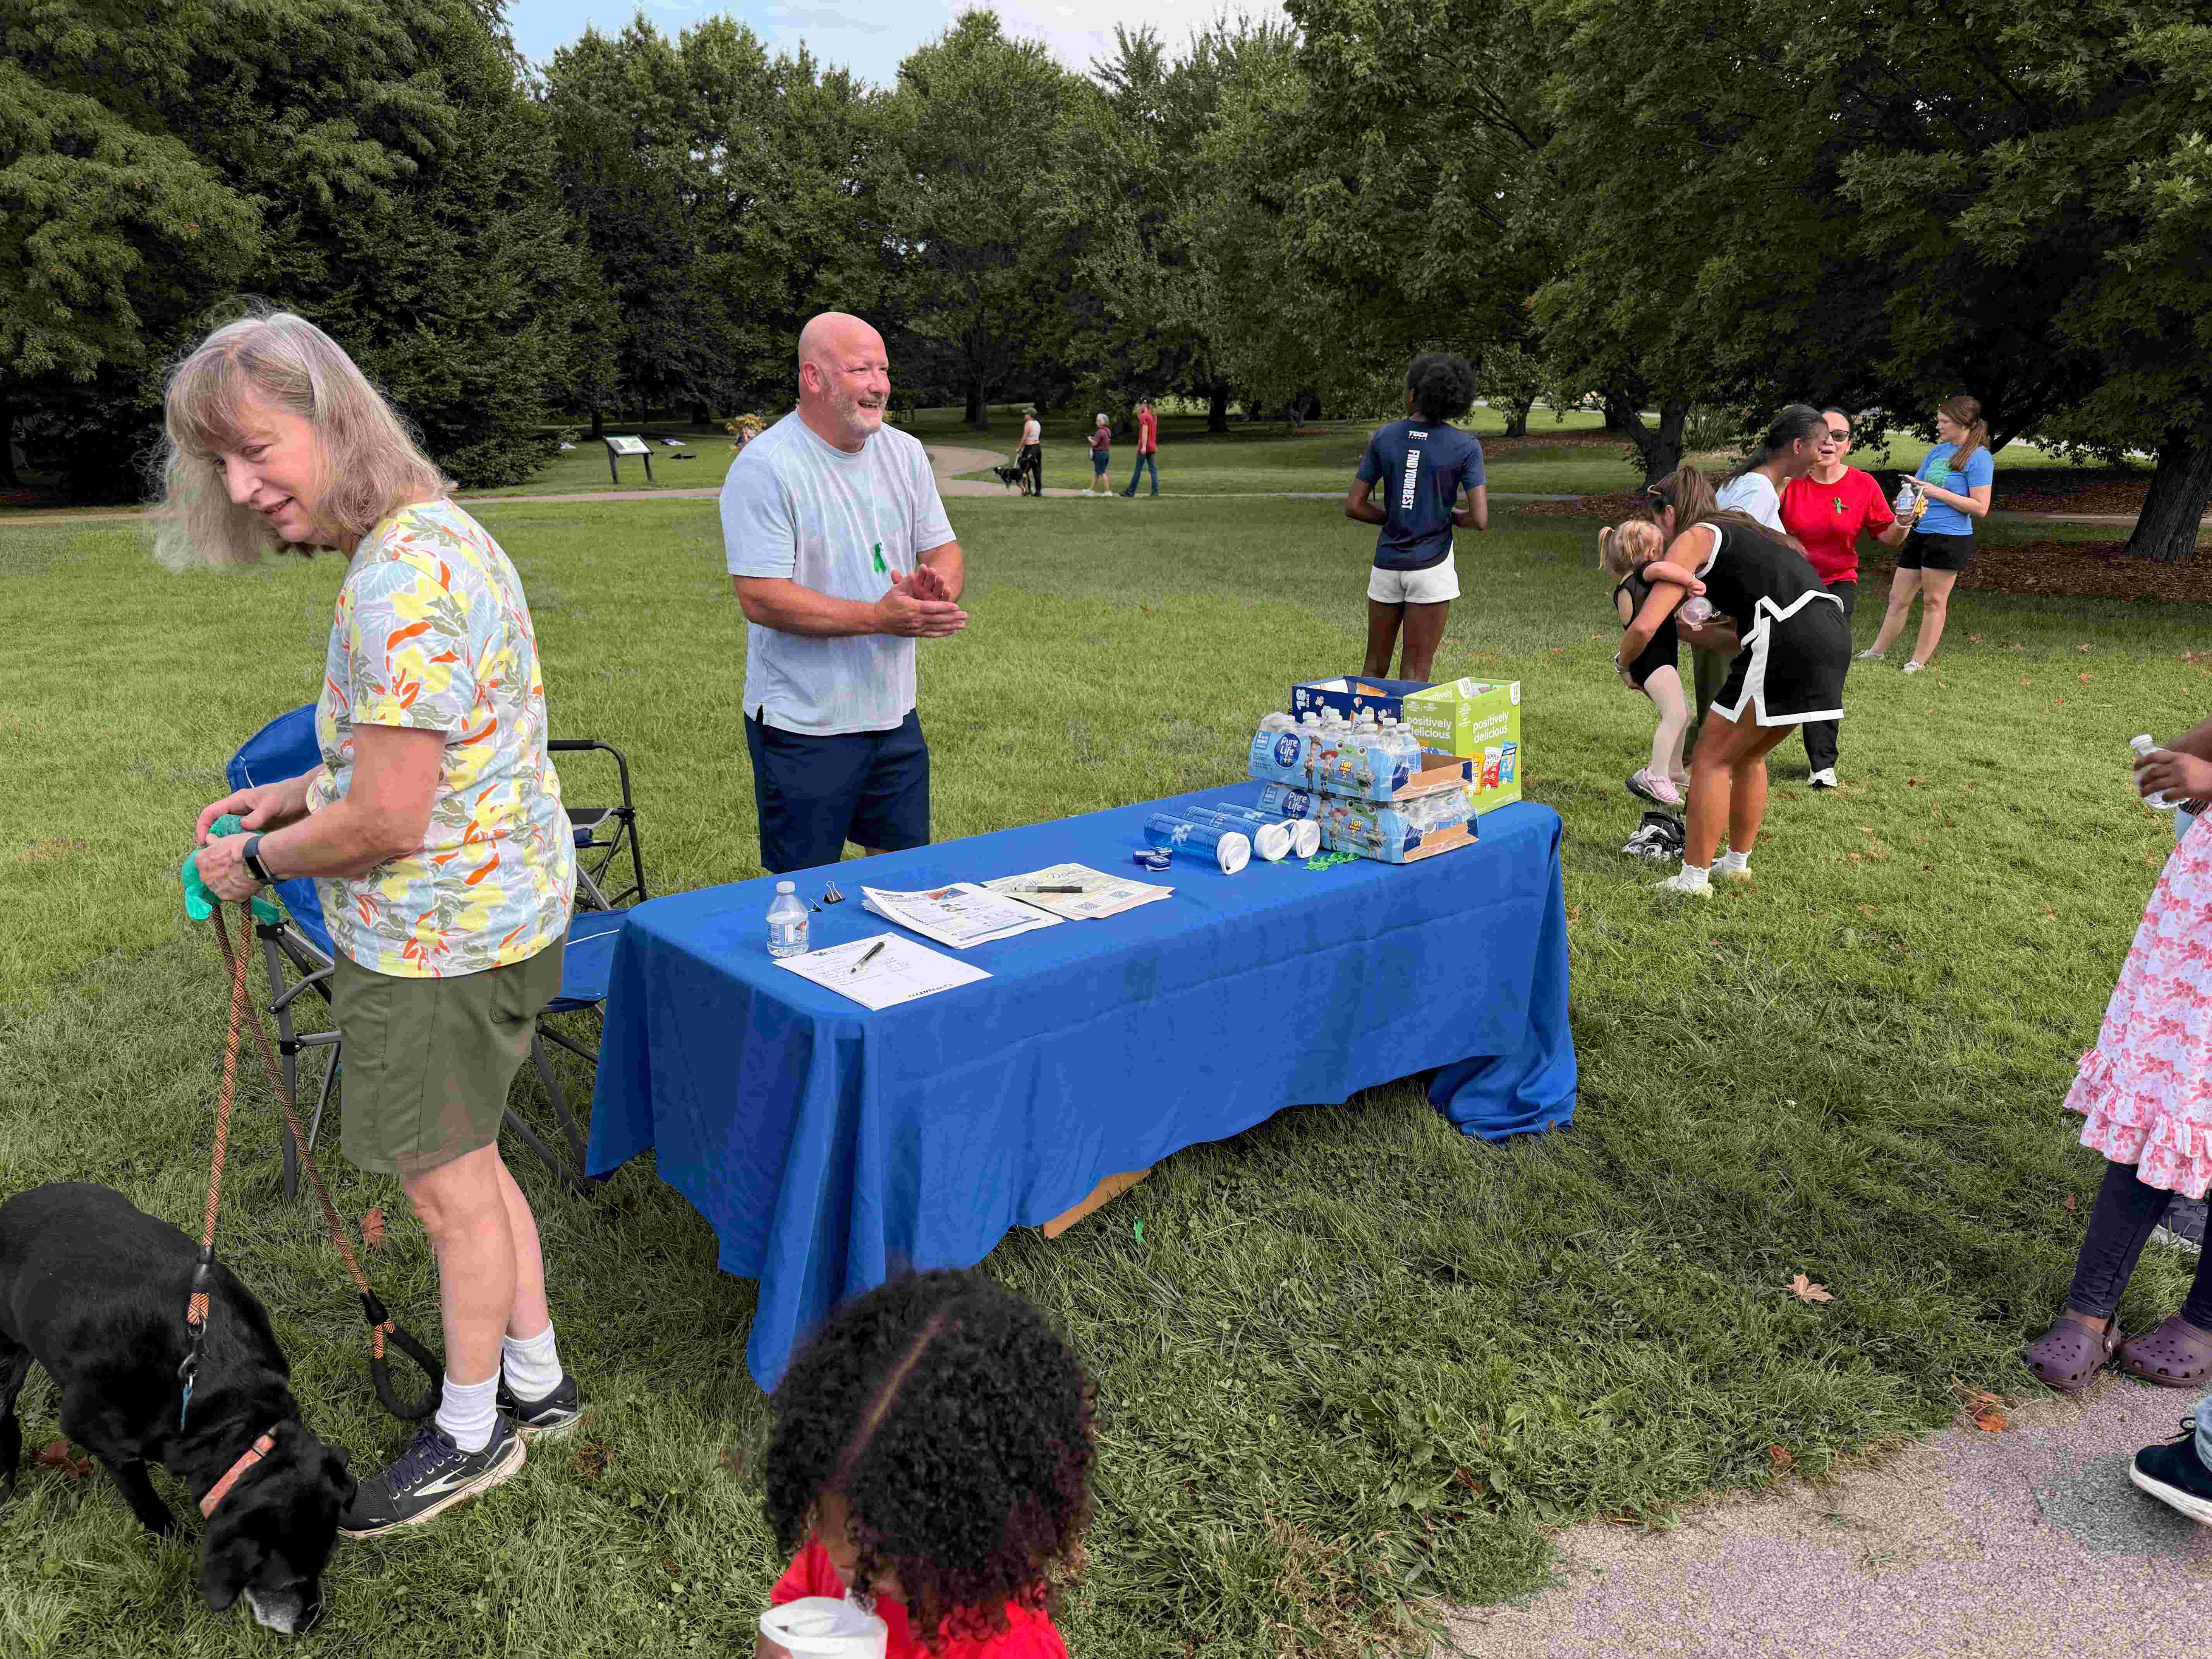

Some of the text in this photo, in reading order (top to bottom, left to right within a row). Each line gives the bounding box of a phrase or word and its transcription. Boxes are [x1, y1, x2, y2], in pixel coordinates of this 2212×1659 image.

[1407, 716, 1452, 730] positively
[1473, 711, 1509, 732] positively
[1474, 724, 1508, 743] delicious
[1281, 736, 1298, 747] Pure
[1280, 745, 1295, 757] Life
[1341, 759, 1354, 769] TOY
[1288, 792, 1307, 803] Pure
[1288, 801, 1302, 812] Life
[1351, 818, 1364, 827] TOY
